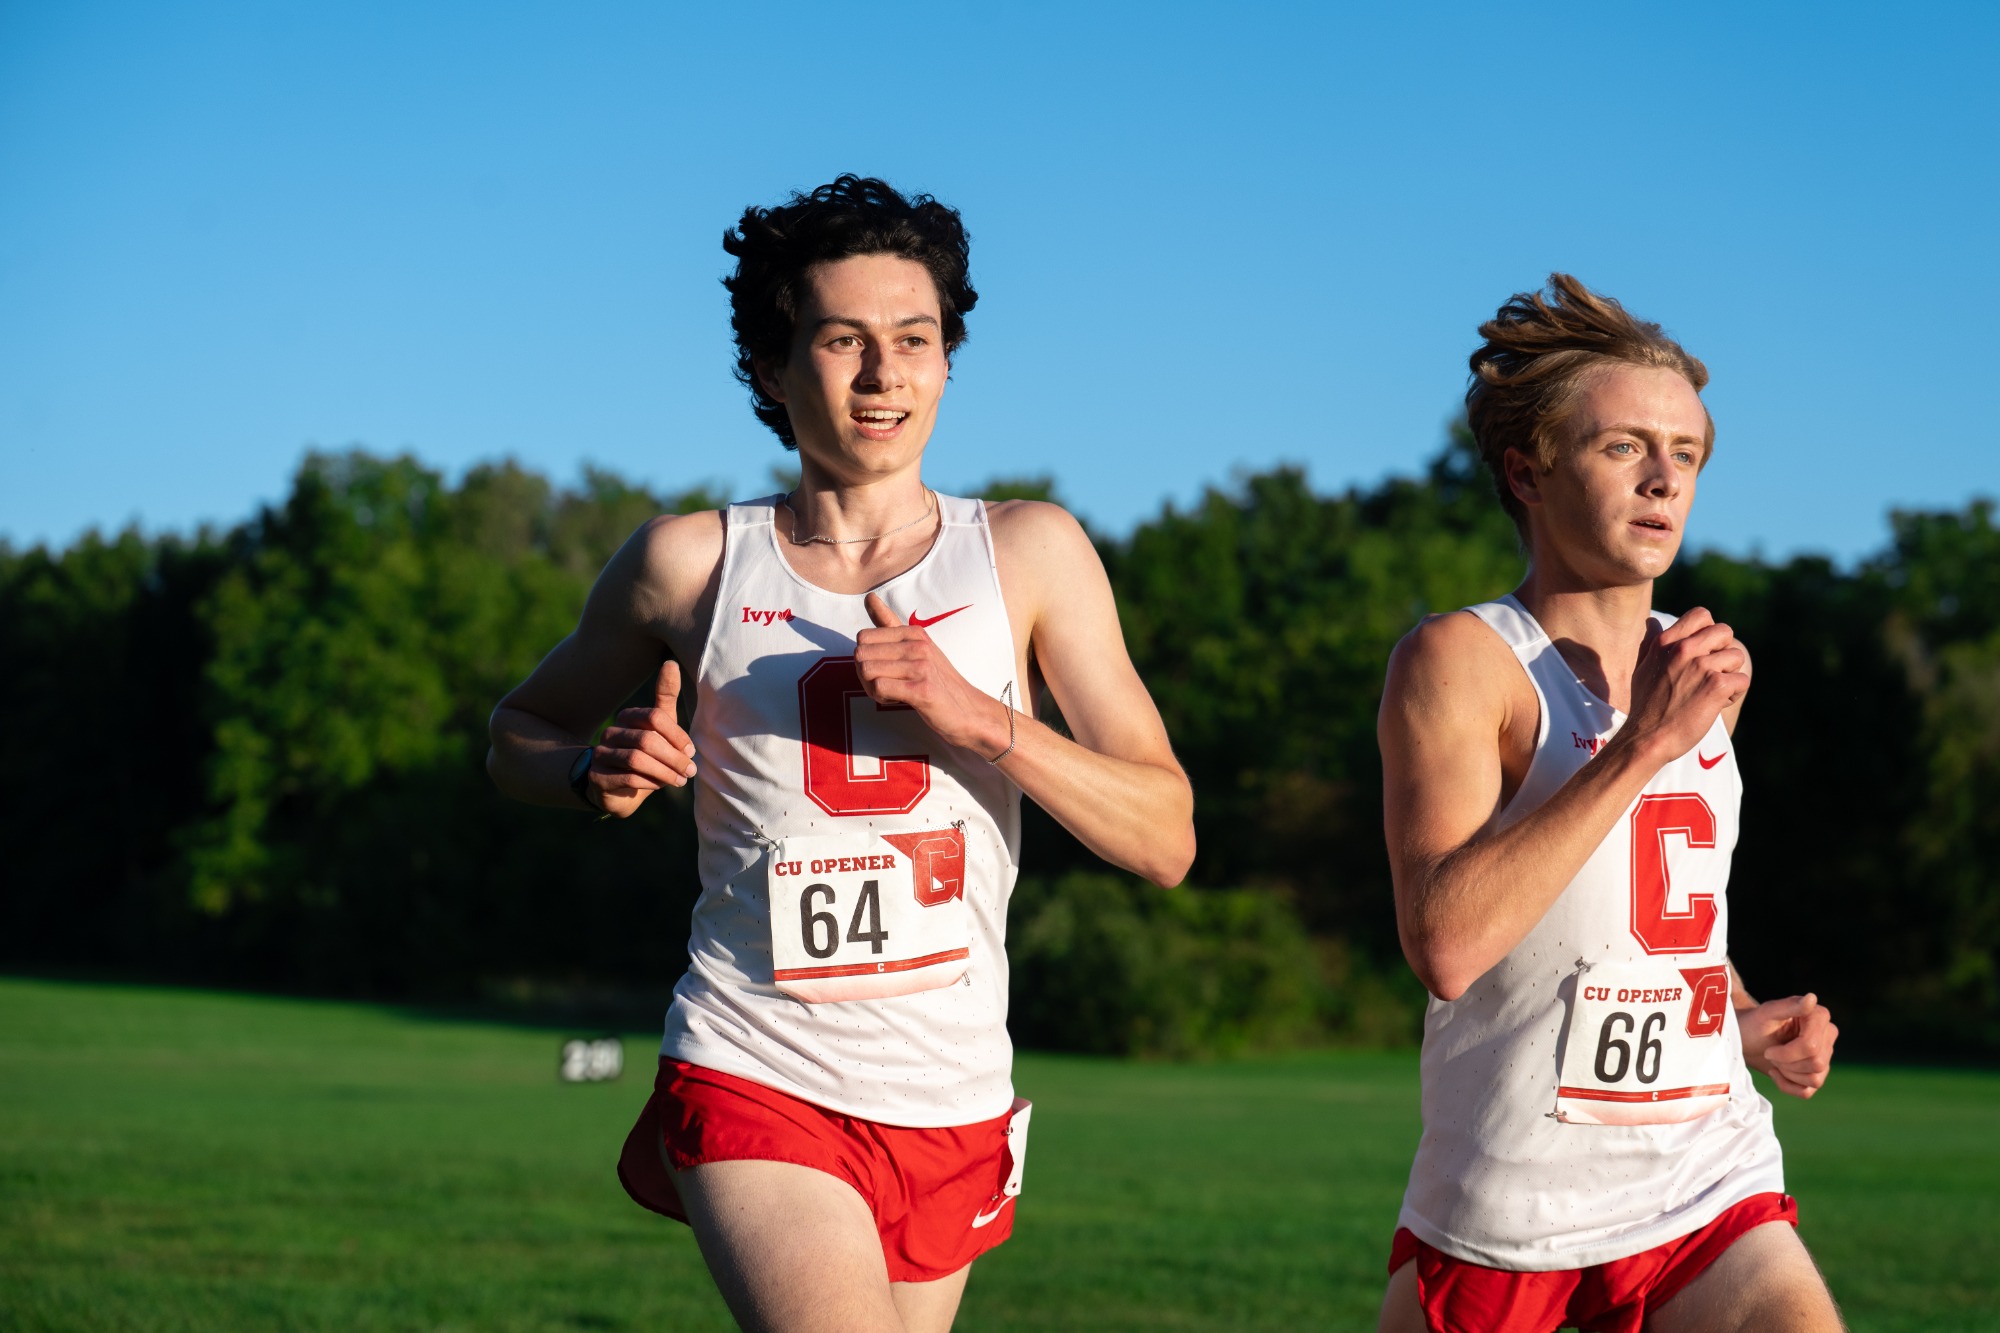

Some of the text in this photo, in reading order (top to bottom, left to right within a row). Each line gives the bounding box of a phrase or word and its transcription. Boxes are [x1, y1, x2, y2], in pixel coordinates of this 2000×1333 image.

[741, 607, 779, 627] Ivy
[798, 656, 931, 817] C
[1571, 731, 1598, 756] Ivy
[774, 854, 897, 877] CU OPENER
[911, 836, 961, 908] C
[1630, 792, 1718, 956] C
[799, 879, 889, 959] 64
[1583, 986, 1683, 1003] CU OPENER
[1684, 972, 1728, 1039] C
[1594, 1011, 1667, 1084] 66
